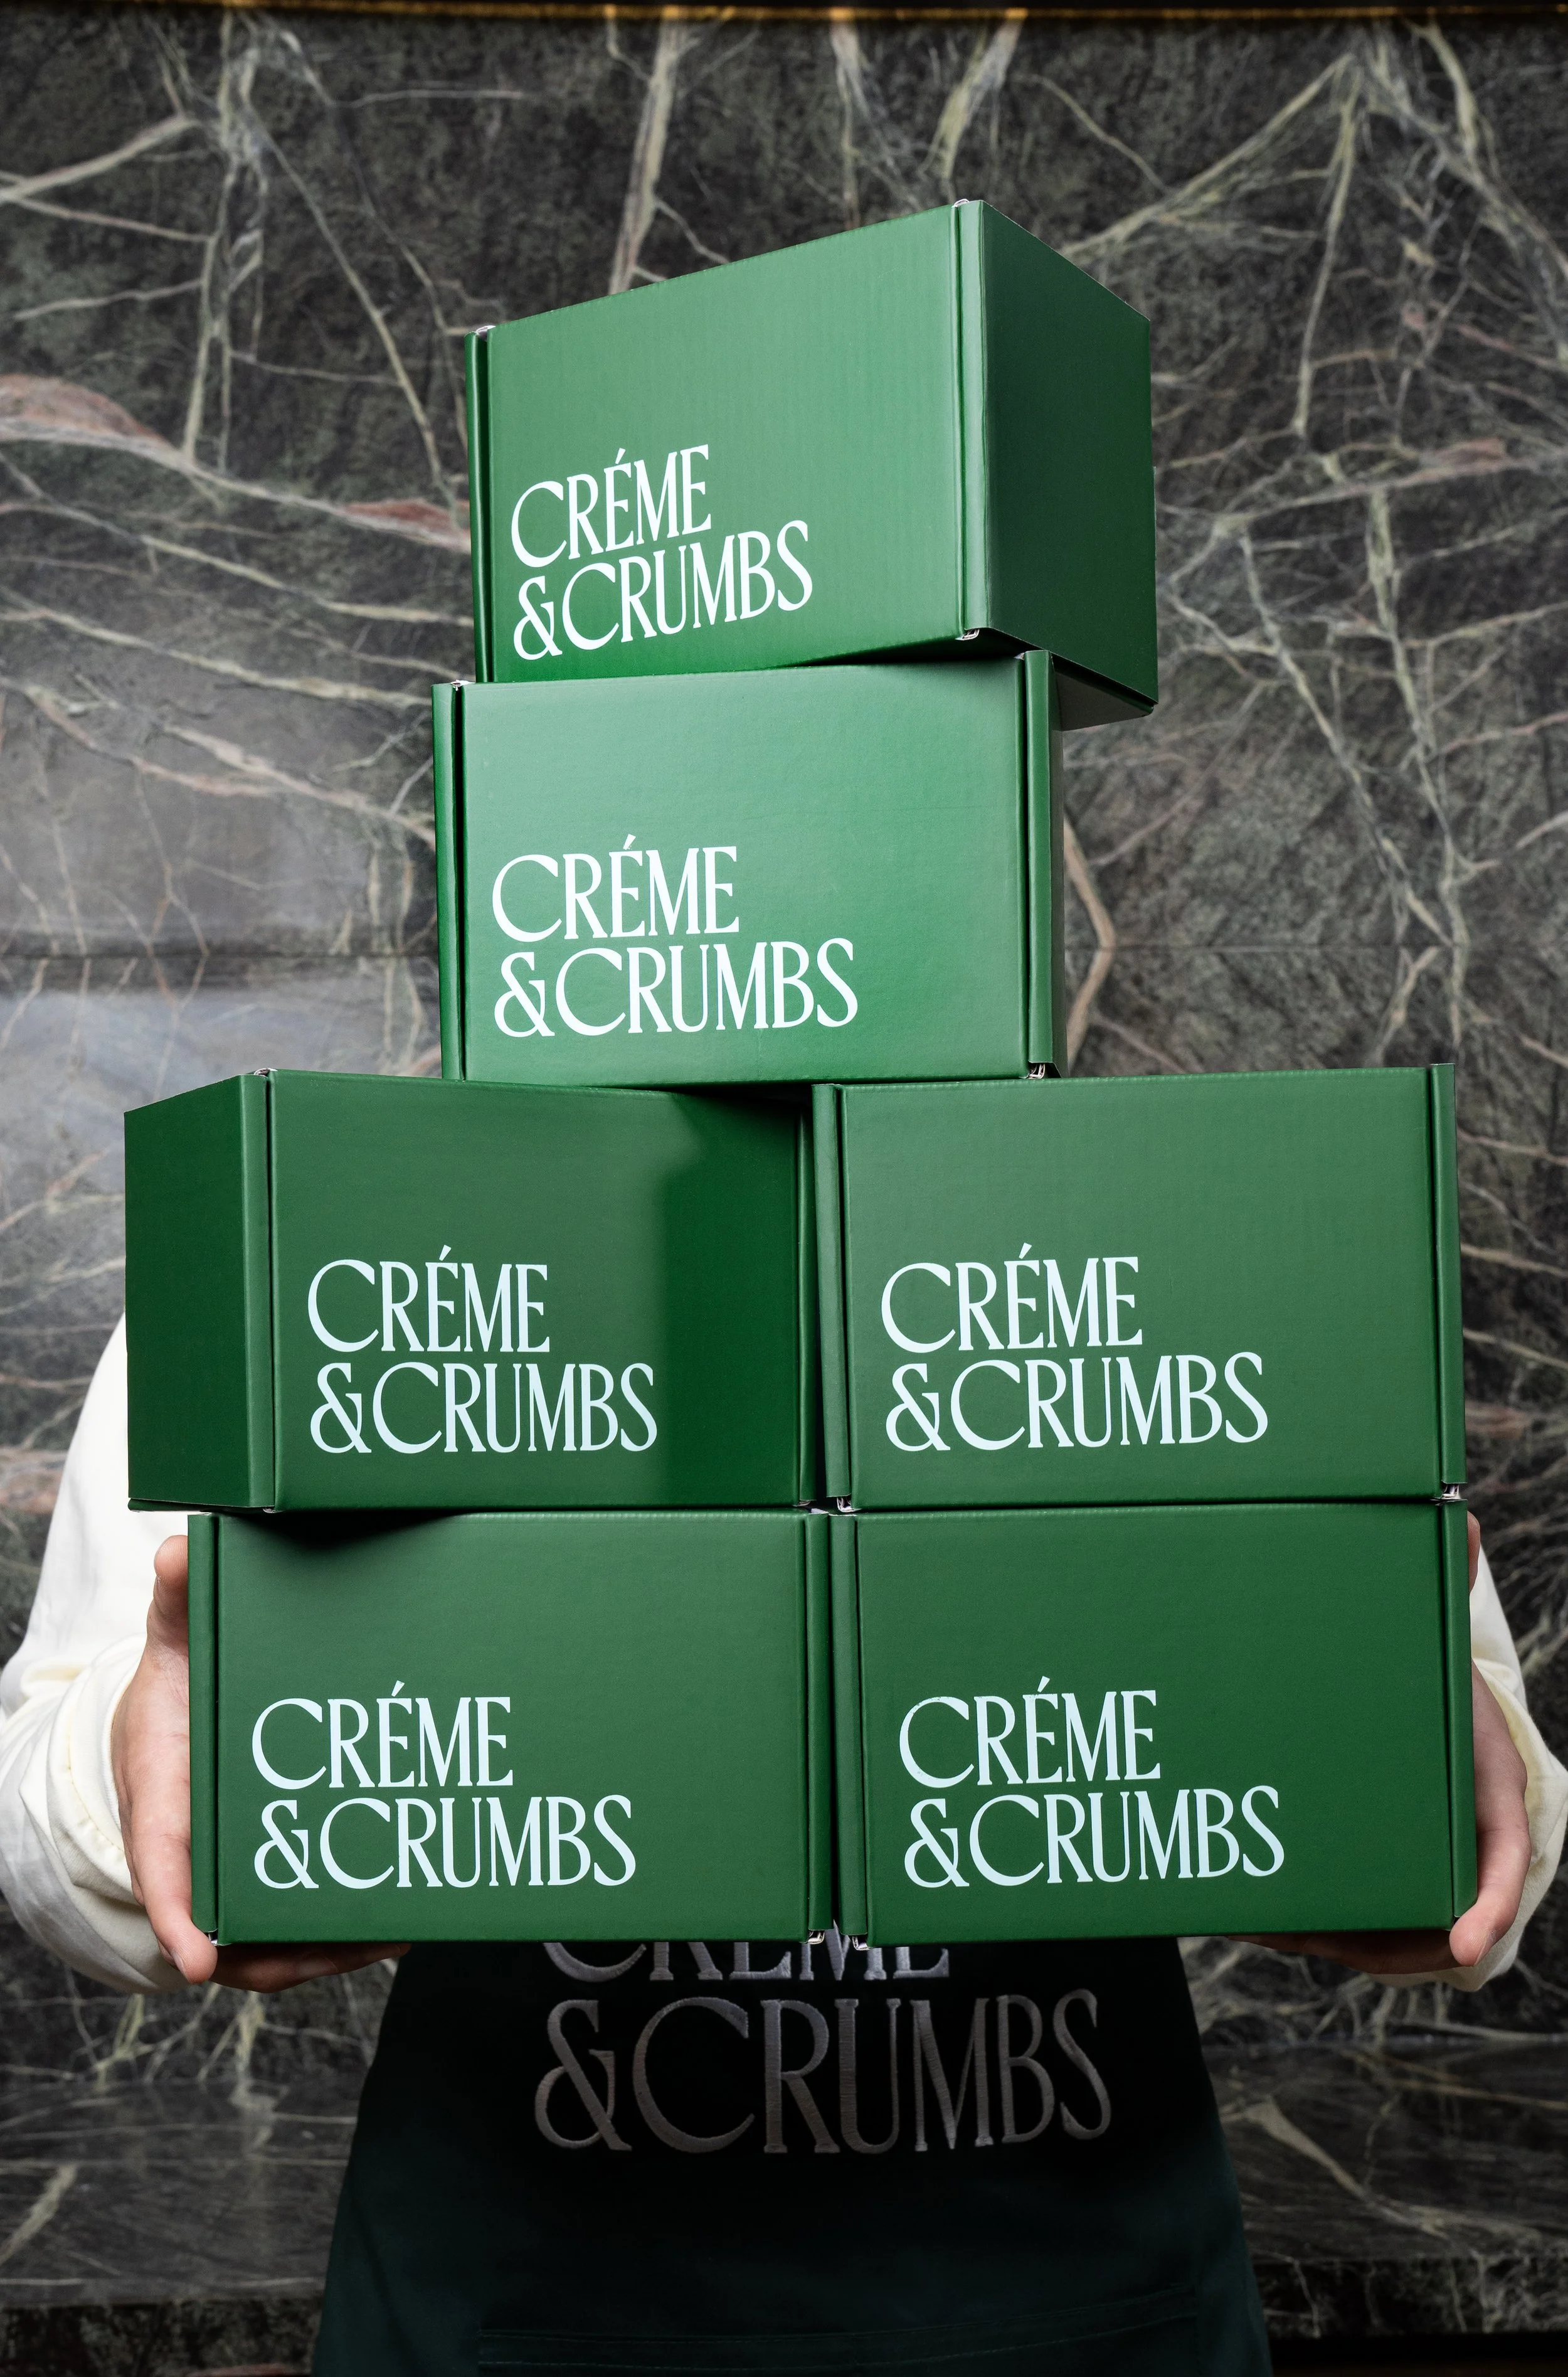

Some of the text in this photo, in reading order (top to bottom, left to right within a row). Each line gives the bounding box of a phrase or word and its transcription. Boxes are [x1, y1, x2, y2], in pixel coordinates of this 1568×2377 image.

[511, 443, 712, 568] CRÉME
[512, 519, 813, 661] &CRUMBS
[491, 832, 740, 944] CRÉME
[493, 937, 859, 1038] &CRUMBS
[307, 1244, 551, 1353] CRÉME
[881, 1242, 1143, 1354] CRÉME
[309, 1361, 658, 1455] &CRUMBS
[885, 1351, 1269, 1452] &CRUMBS
[251, 1679, 514, 1790] CRÉME
[899, 1675, 1161, 1789] CRÉME
[253, 1794, 637, 1890] &CRUMBS
[903, 1785, 1285, 1889] &CRUMBS
[534, 1988, 1112, 2154] &CRUMBS
